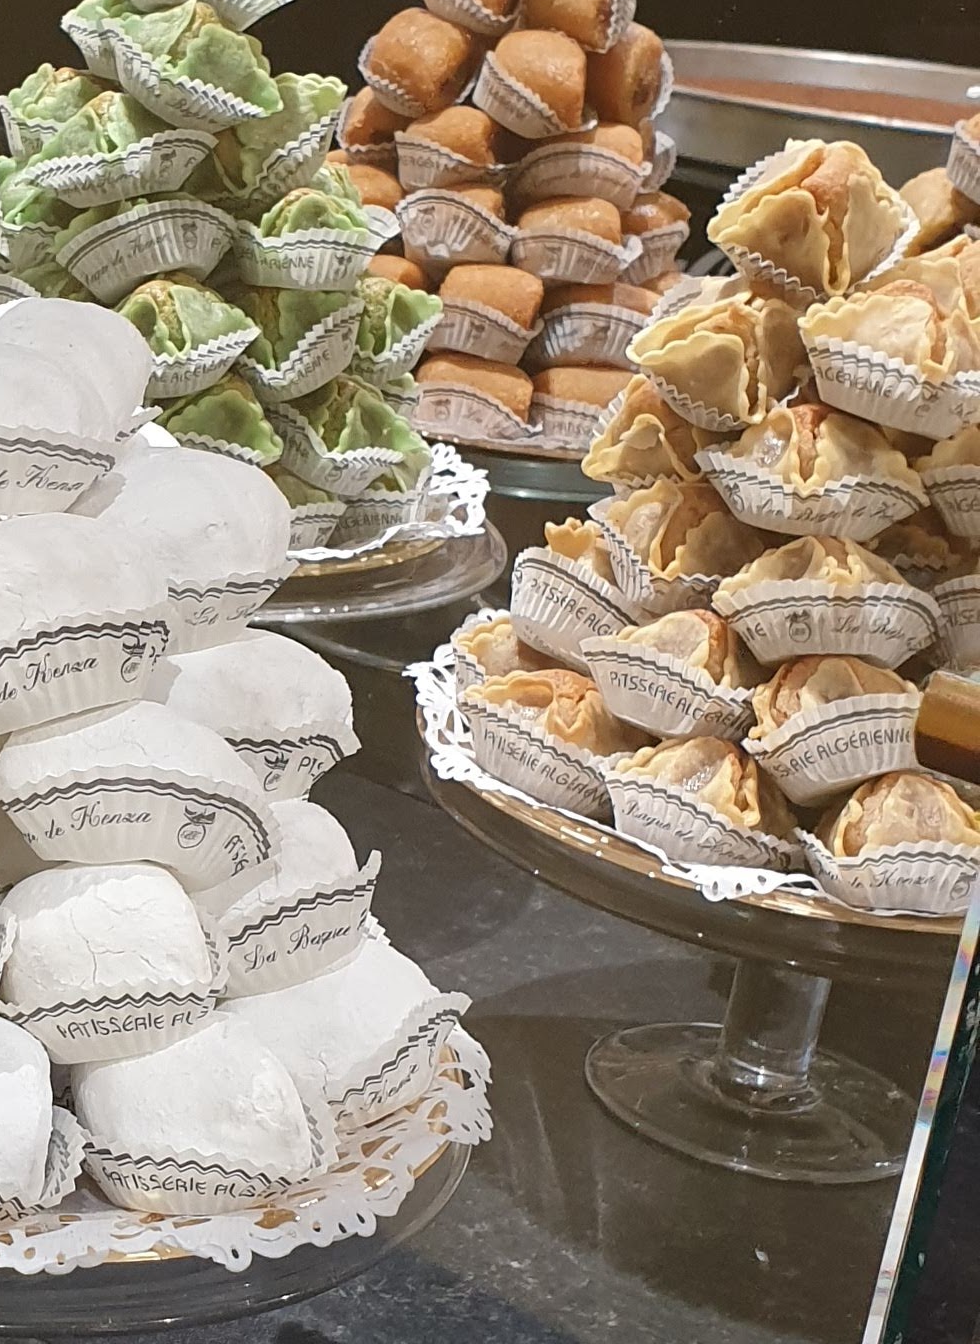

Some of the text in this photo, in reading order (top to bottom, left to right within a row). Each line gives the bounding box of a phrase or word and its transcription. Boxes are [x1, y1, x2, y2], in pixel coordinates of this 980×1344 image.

[22, 651, 100, 692] Kenza
[44, 819, 66, 840] de
[70, 800, 153, 832] Kenza
[243, 922, 353, 974] La Bague
[102, 1166, 208, 1196] PATISSERIE
